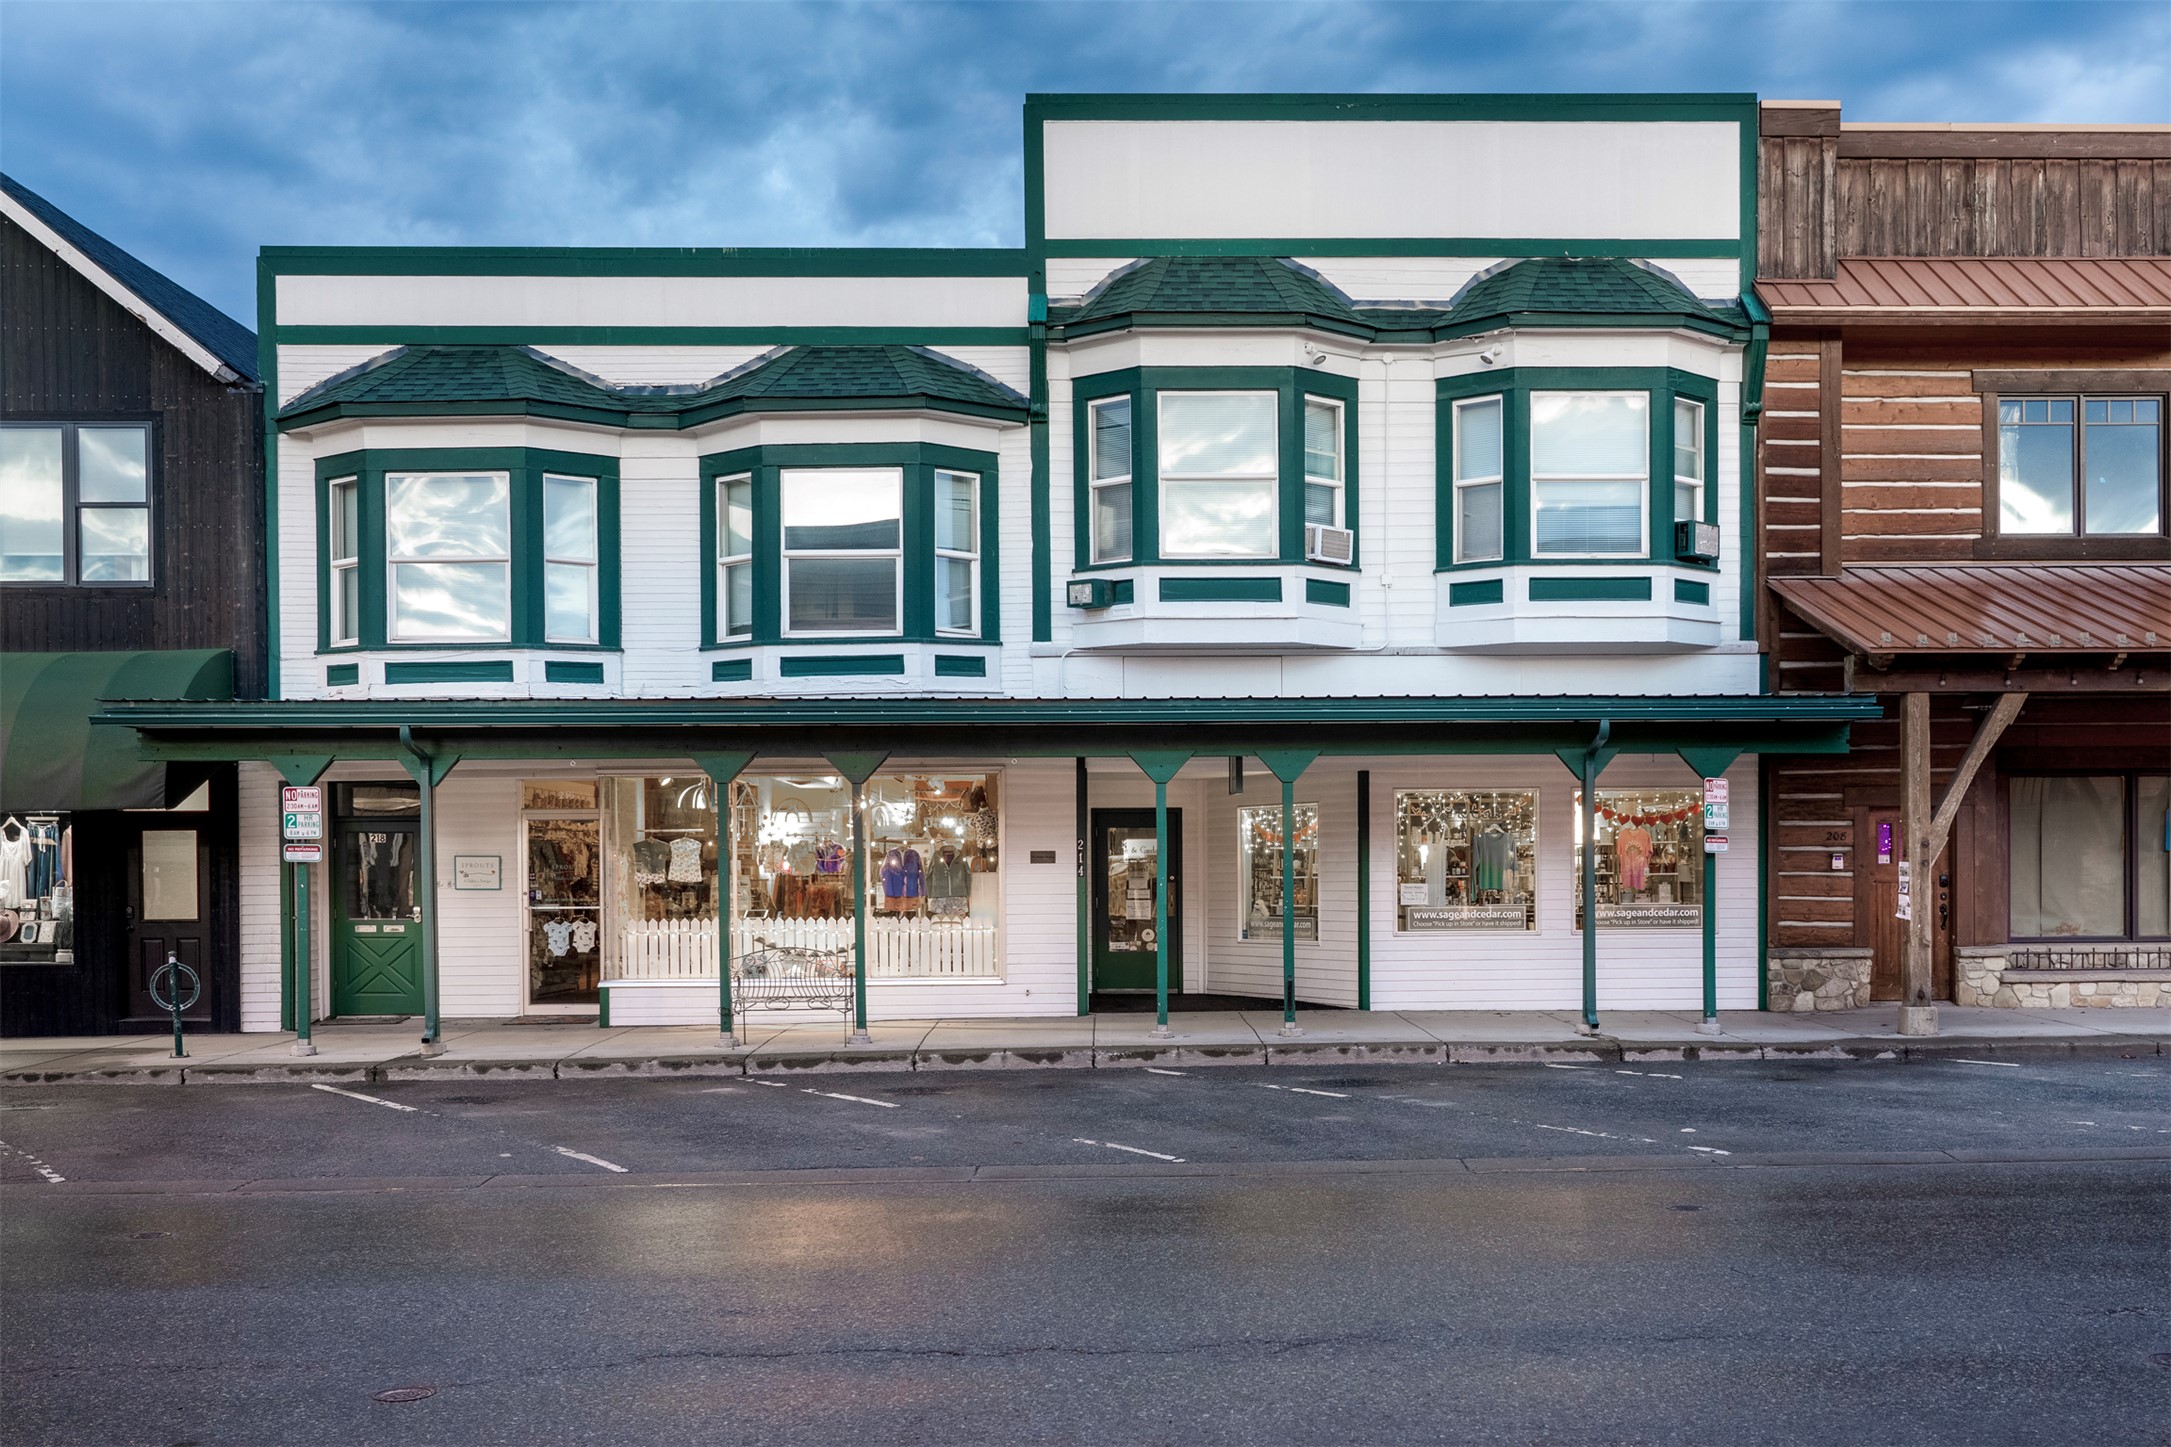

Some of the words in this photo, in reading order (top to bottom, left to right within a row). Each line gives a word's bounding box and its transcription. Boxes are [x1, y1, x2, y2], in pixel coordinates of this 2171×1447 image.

[1705, 781, 1713, 791] NO
[285, 789, 297, 801] NO
[297, 791, 318, 799] PARKING
[1706, 805, 1713, 818] 2
[287, 815, 296, 828] 2
[370, 834, 386, 843] 218
[1413, 909, 1522, 921] www.sageandcedar.com
[1250, 920, 1312, 929] www.sageanar.com
